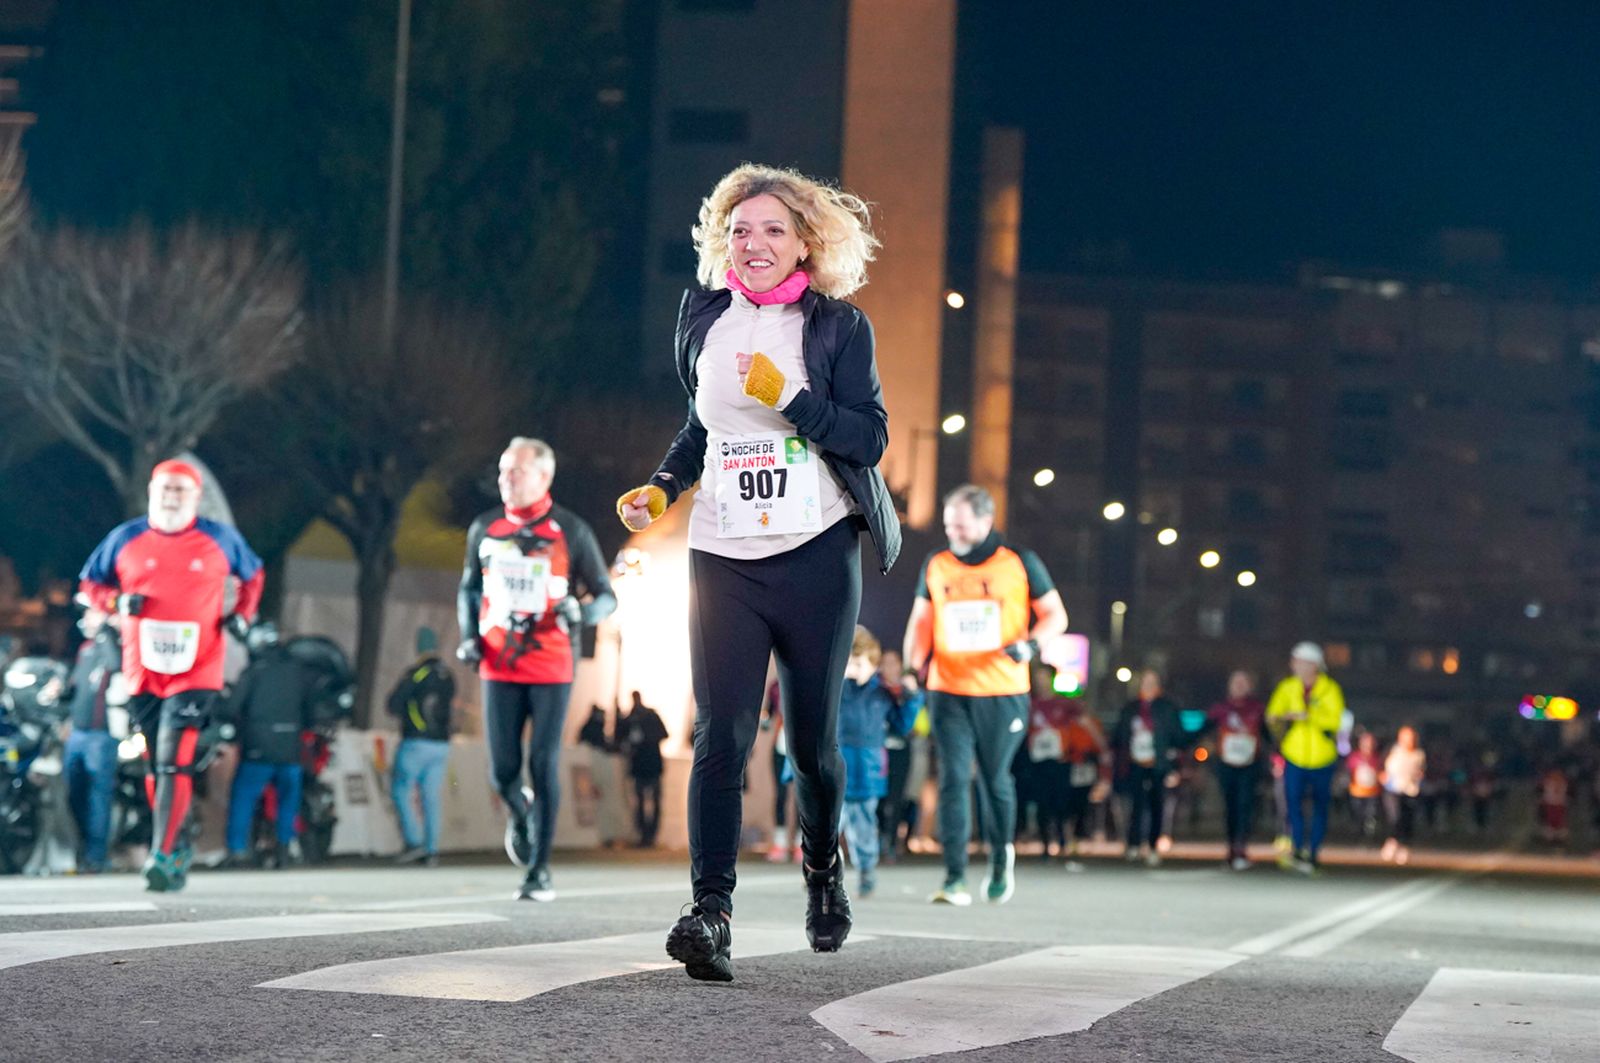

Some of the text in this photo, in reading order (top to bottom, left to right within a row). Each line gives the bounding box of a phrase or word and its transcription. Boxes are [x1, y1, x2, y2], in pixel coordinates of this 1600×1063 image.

[732, 444, 761, 456] NOCHE
[762, 443, 775, 453] DE
[723, 459, 740, 470] SAN
[741, 454, 775, 469] ANTÓN
[739, 468, 787, 501] 907
